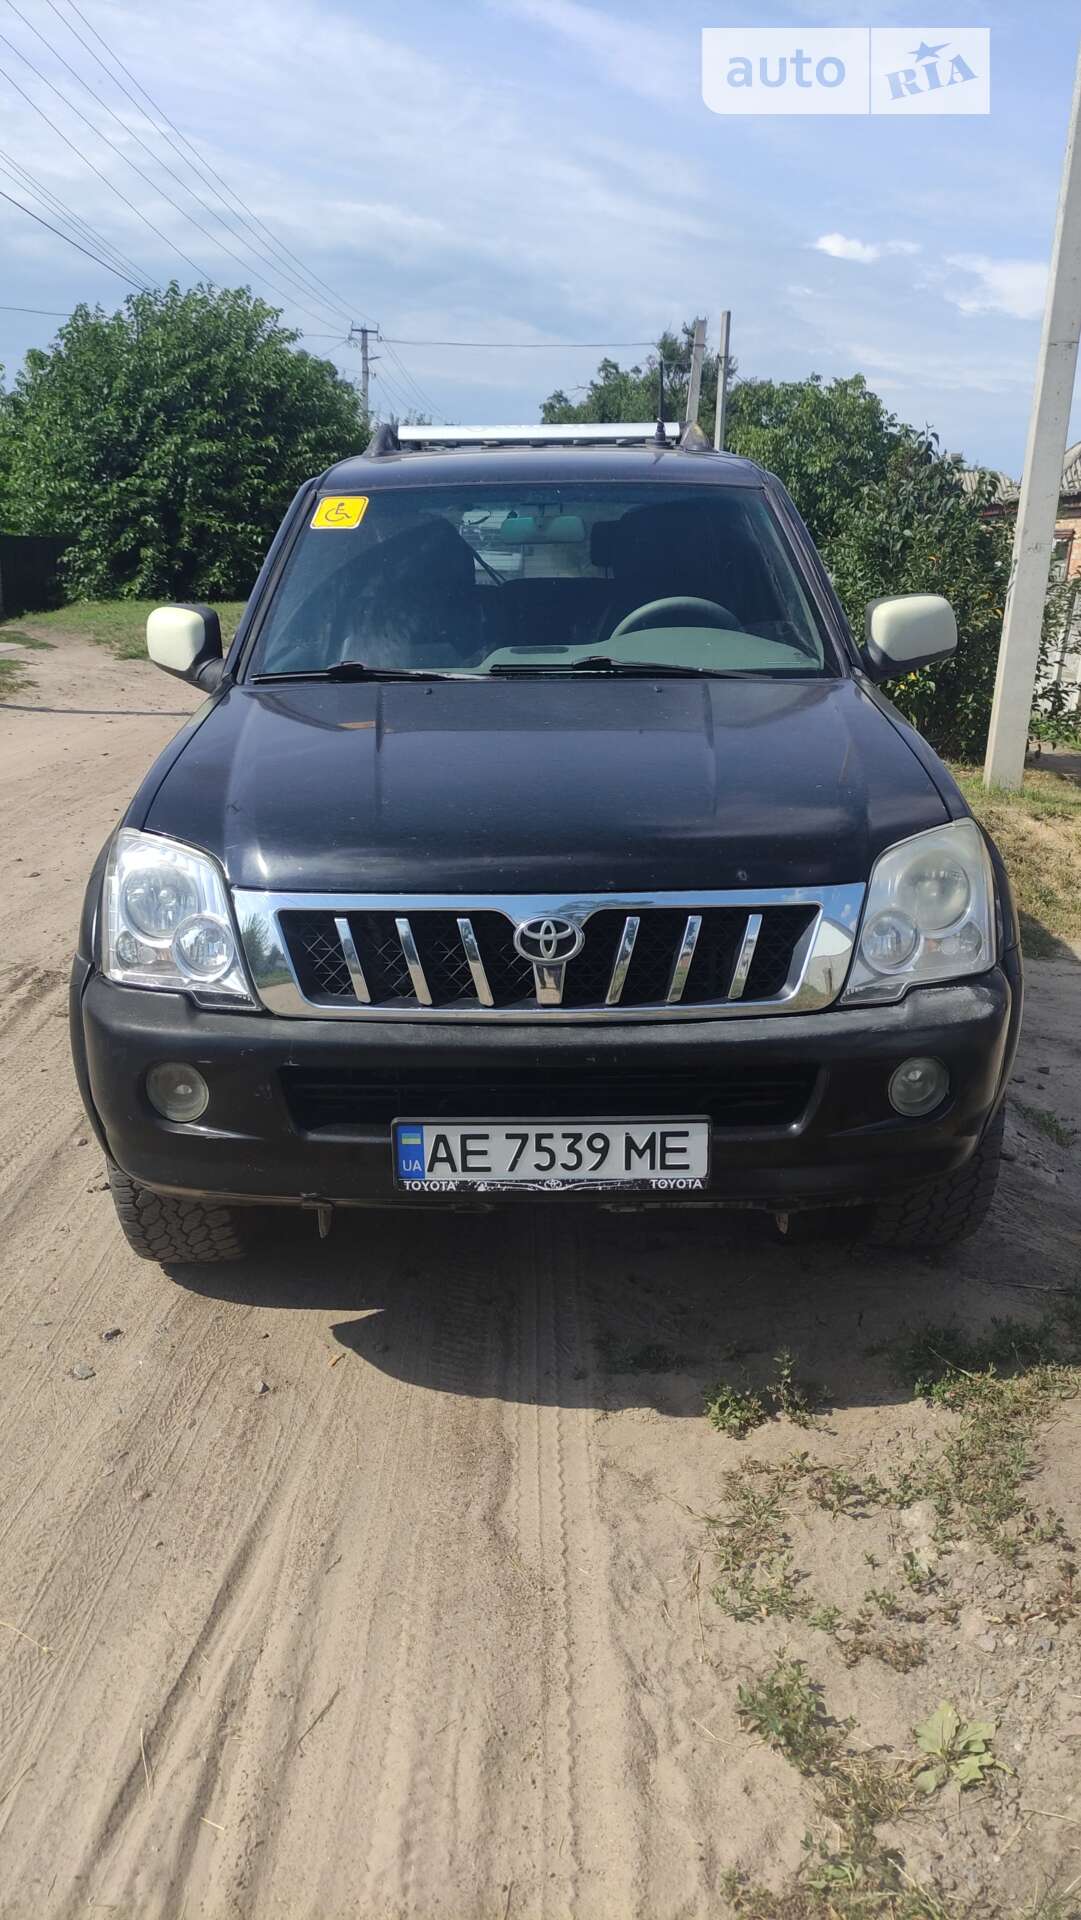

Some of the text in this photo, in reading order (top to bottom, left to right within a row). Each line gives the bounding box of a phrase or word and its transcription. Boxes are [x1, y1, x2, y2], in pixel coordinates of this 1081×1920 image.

[426, 1130, 690, 1173] AE 7539 ME
[402, 1160, 423, 1172] UA
[403, 1180, 457, 1191] TOYOTA
[651, 1179, 704, 1189] TOYOTA
